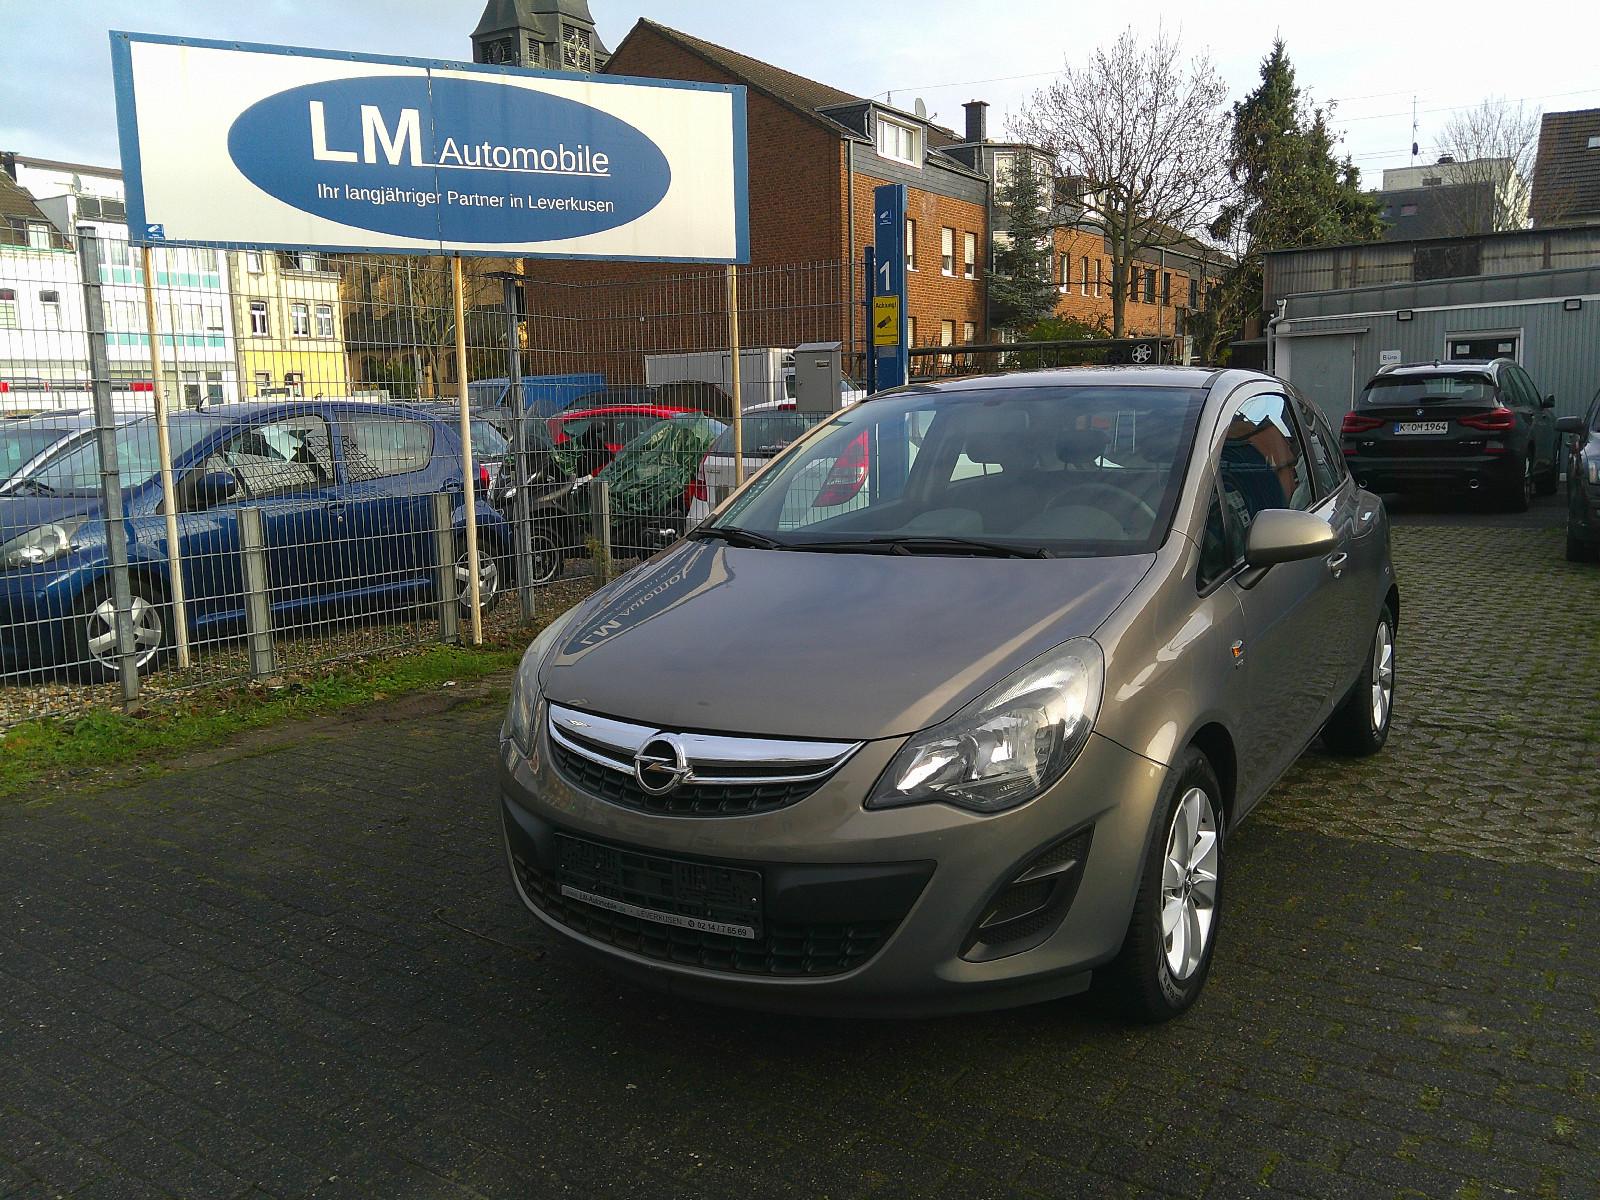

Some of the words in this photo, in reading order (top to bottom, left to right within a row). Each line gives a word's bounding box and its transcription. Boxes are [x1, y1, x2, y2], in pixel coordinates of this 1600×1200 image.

[309, 100, 423, 167] LM
[438, 137, 610, 174] Automobile
[317, 183, 340, 199] Ihr
[345, 184, 442, 207] langjähriger
[447, 190, 505, 208] Partner
[509, 193, 524, 208] in
[528, 195, 614, 213] Leverkusen
[879, 260, 891, 291] 1
[1424, 422, 1447, 432] 1964
